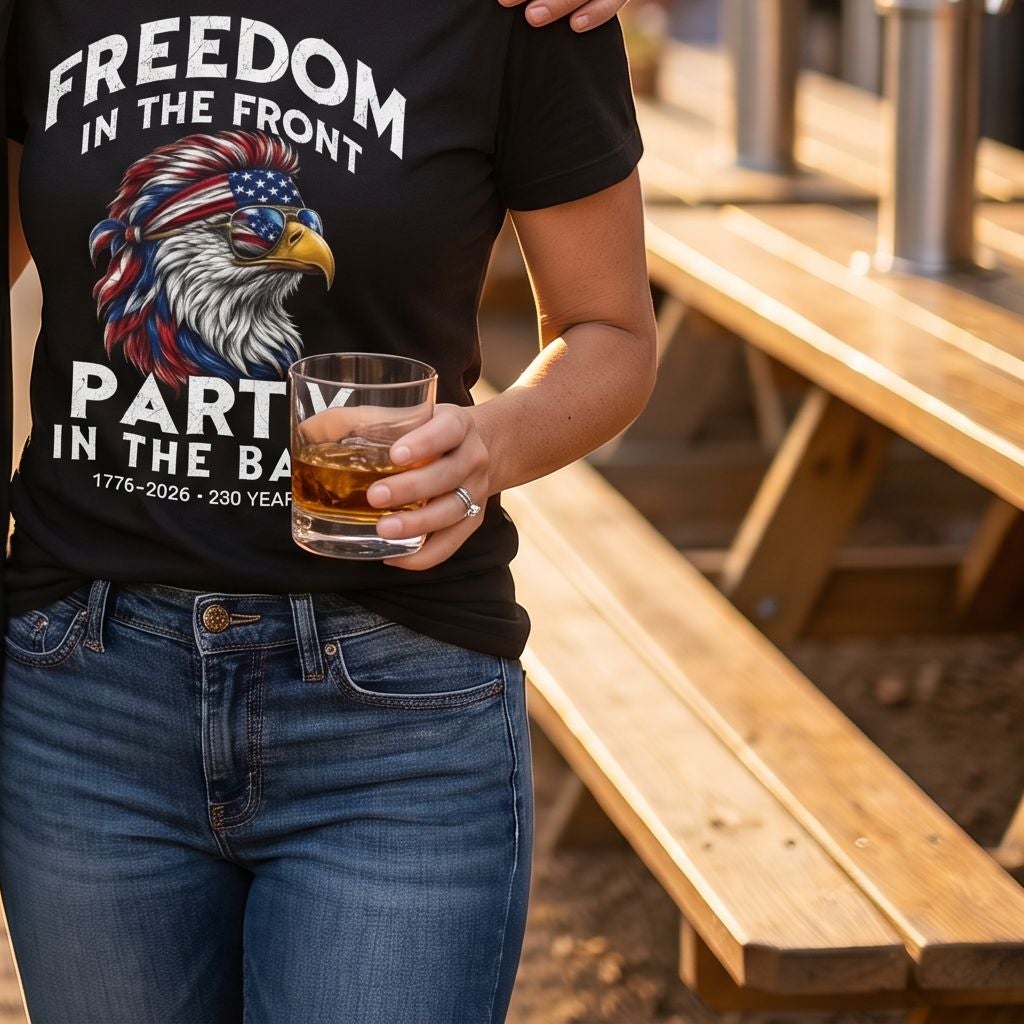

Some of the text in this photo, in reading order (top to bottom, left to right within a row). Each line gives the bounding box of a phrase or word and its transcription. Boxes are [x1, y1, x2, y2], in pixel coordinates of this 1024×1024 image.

[44, 15, 407, 161] FREEDOM
[80, 90, 363, 175] IN THE FRONT
[52, 423, 292, 482] IN THE BA
[92, 472, 191, 502] 1776-2026
[208, 489, 242, 506] 230
